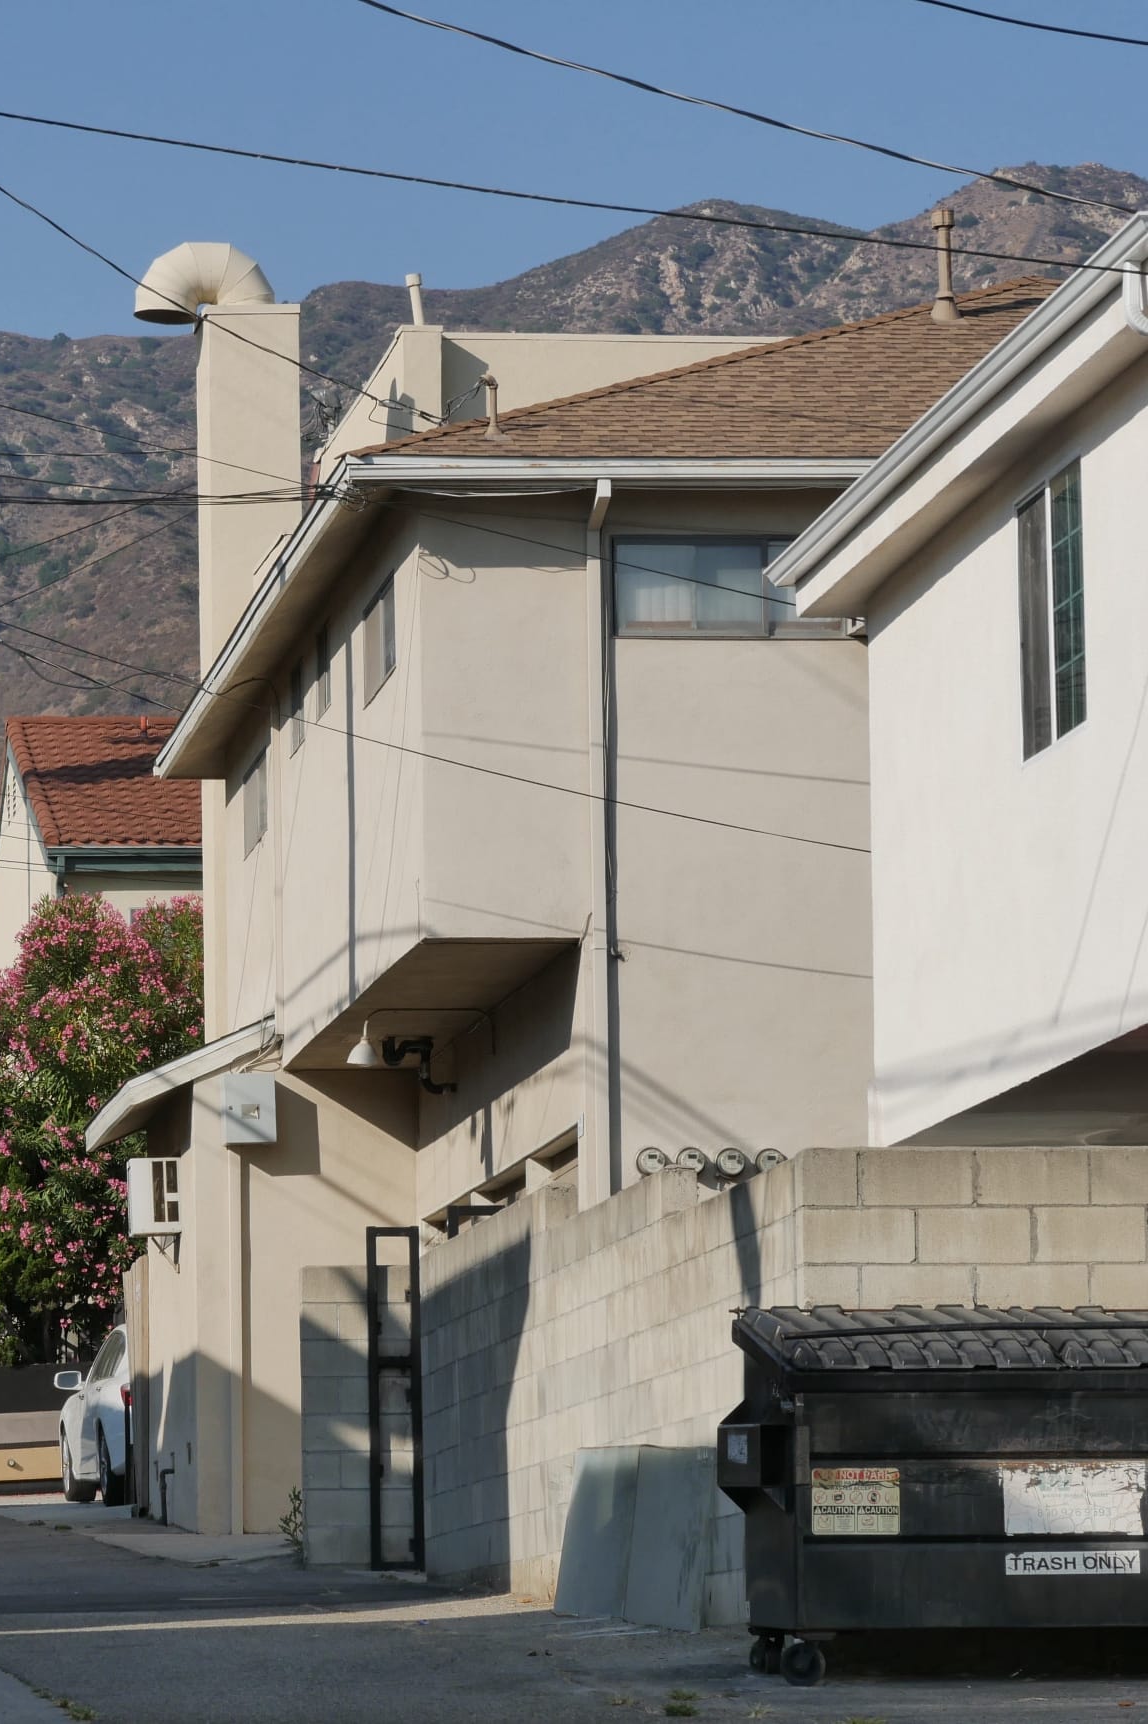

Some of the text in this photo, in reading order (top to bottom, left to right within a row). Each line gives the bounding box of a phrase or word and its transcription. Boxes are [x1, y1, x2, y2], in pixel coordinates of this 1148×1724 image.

[840, 1470, 860, 1479] NOT
[821, 1506, 855, 1514] CAUTION
[865, 1506, 898, 1514] CAUTION
[1009, 1555, 1137, 1570] TRASH ONLY
